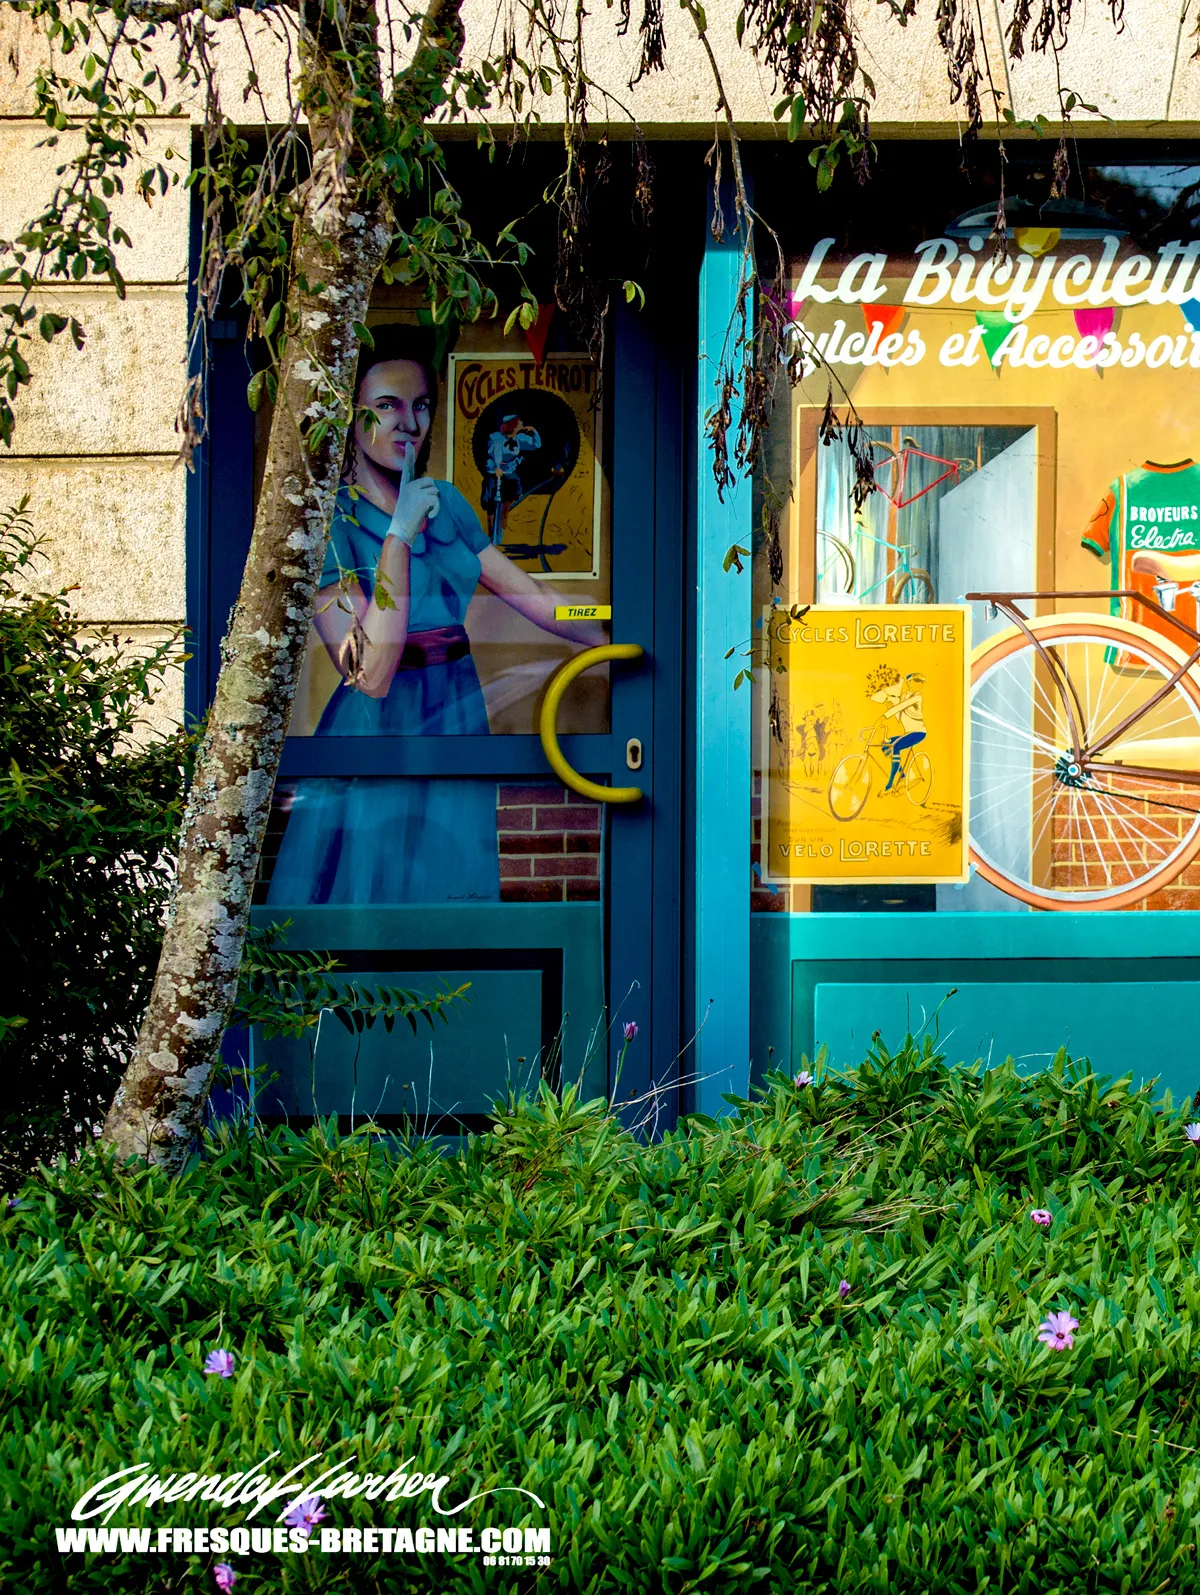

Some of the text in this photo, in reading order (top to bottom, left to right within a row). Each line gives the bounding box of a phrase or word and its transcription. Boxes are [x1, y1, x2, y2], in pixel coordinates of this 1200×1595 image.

[792, 237, 888, 305] La
[939, 323, 985, 368] et
[458, 363, 595, 420] CYCLES TERROT
[1130, 505, 1198, 522] BROYEURS
[567, 608, 597, 617] TIREZ
[776, 618, 955, 649] CYCLES LORETTE
[779, 838, 932, 862] VELO LORETTE
